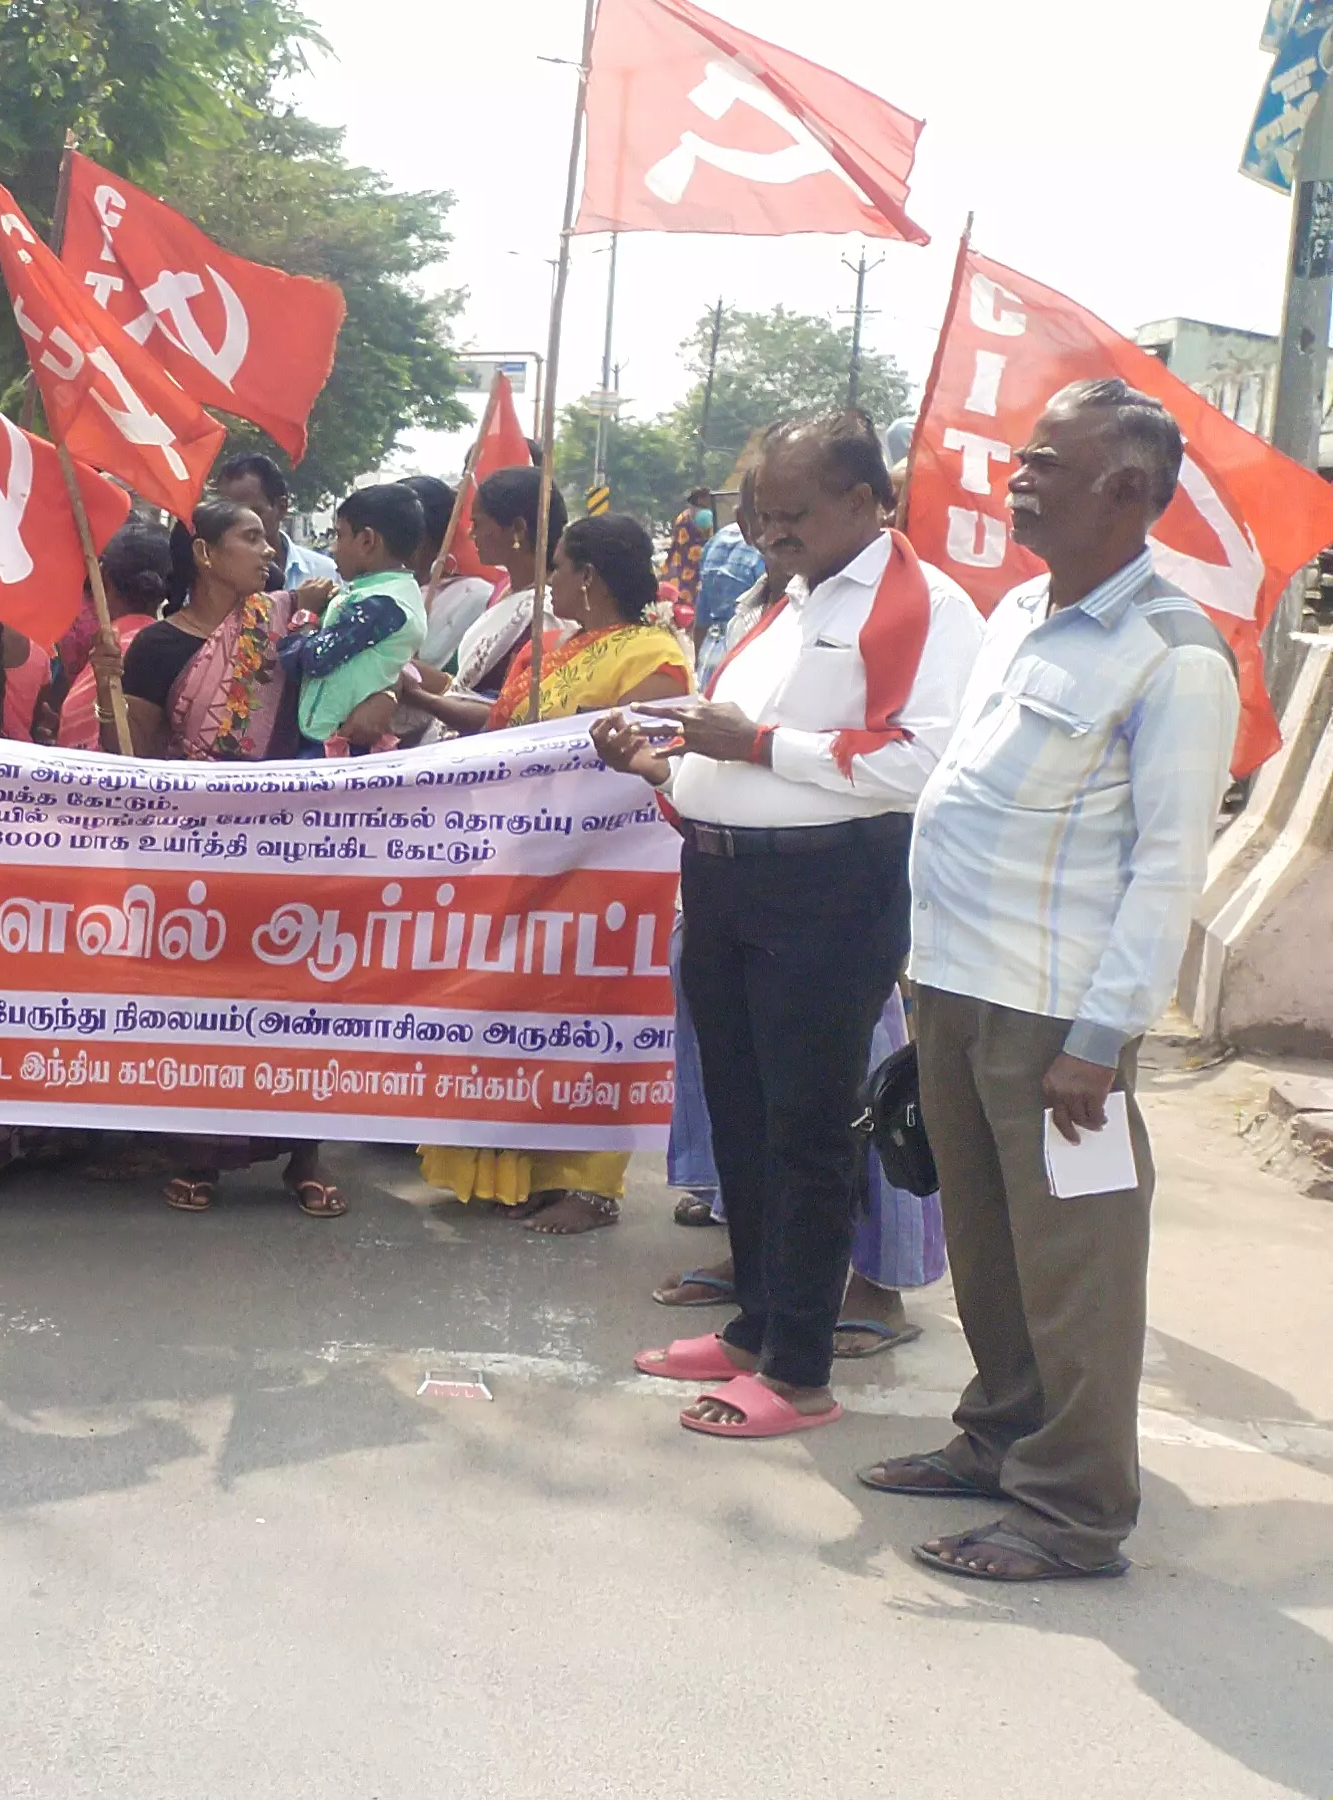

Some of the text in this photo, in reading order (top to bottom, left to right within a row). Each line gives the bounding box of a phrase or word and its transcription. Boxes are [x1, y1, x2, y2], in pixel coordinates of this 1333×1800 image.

[943, 272, 1027, 568] CITU
[302, 806, 435, 829] பொங்கல்
[444, 808, 572, 835] தொகுப்பு
[69, 836, 129, 850] மாக
[138, 830, 248, 859] உயர்த்தி
[256, 837, 378, 863] வழங்கிட
[387, 838, 496, 864] கேட்டும்
[251, 882, 671, 982] ஆர்ப்பாட்ட
[483, 1018, 624, 1053] அருகில்),
[20, 1050, 109, 1087] இந்திய
[118, 1057, 245, 1090] கட்டுமான
[254, 1060, 425, 1099] தொழிலாளர்
[552, 1071, 621, 1111] பதிவு
